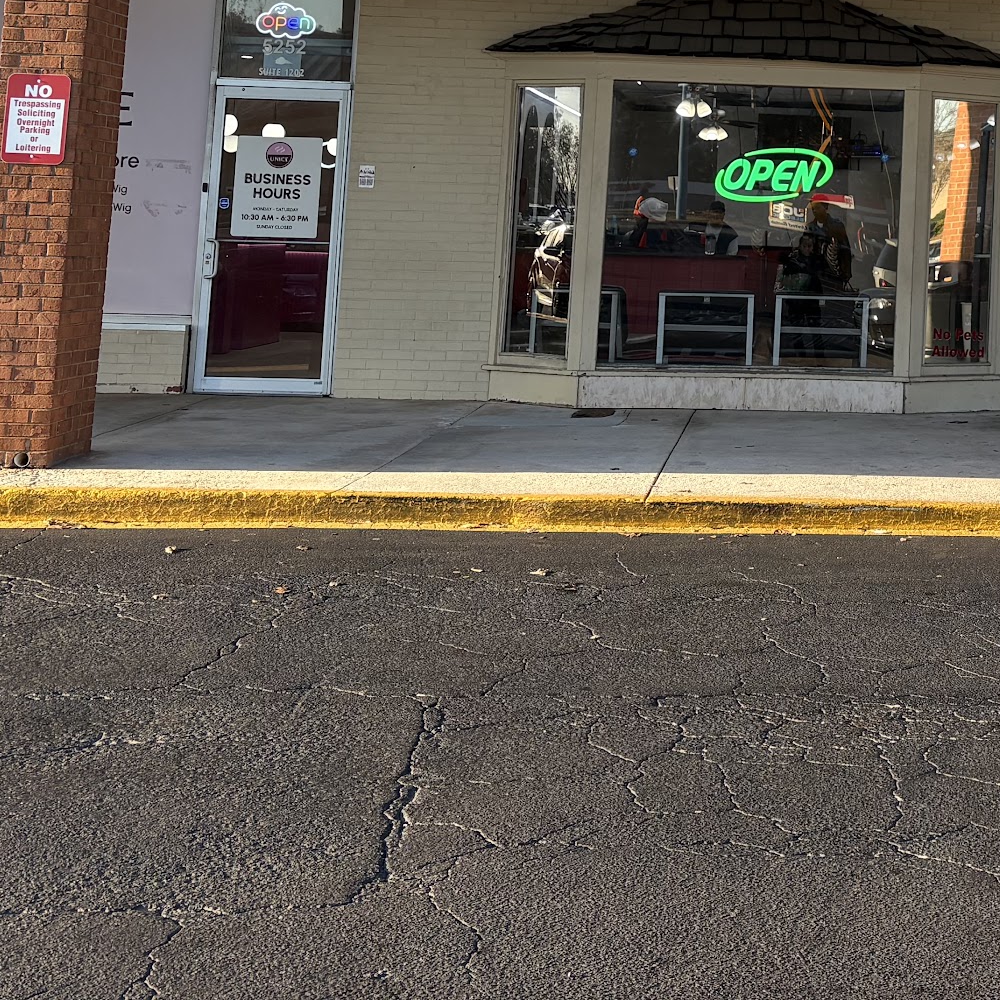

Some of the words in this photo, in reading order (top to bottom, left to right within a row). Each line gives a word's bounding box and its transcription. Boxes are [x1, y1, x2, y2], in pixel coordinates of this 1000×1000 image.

[262, 38, 306, 55] 5252
[258, 67, 281, 76] SUITE
[285, 68, 305, 77] 1202
[24, 84, 53, 98] NO
[14, 99, 61, 109] Trespassing
[17, 109, 56, 118] Soliciting
[16, 118, 55, 127] Overnight
[20, 126, 50, 135] Parking
[15, 143, 51, 153] Loitering
[244, 173, 312, 186] BUSINESS
[723, 158, 821, 192] OPEN
[253, 187, 301, 199] HOURS
[113, 203, 132, 214] Wig
[933, 328, 951, 341] No
[955, 328, 984, 341] Pets
[931, 345, 985, 358] Allowed
